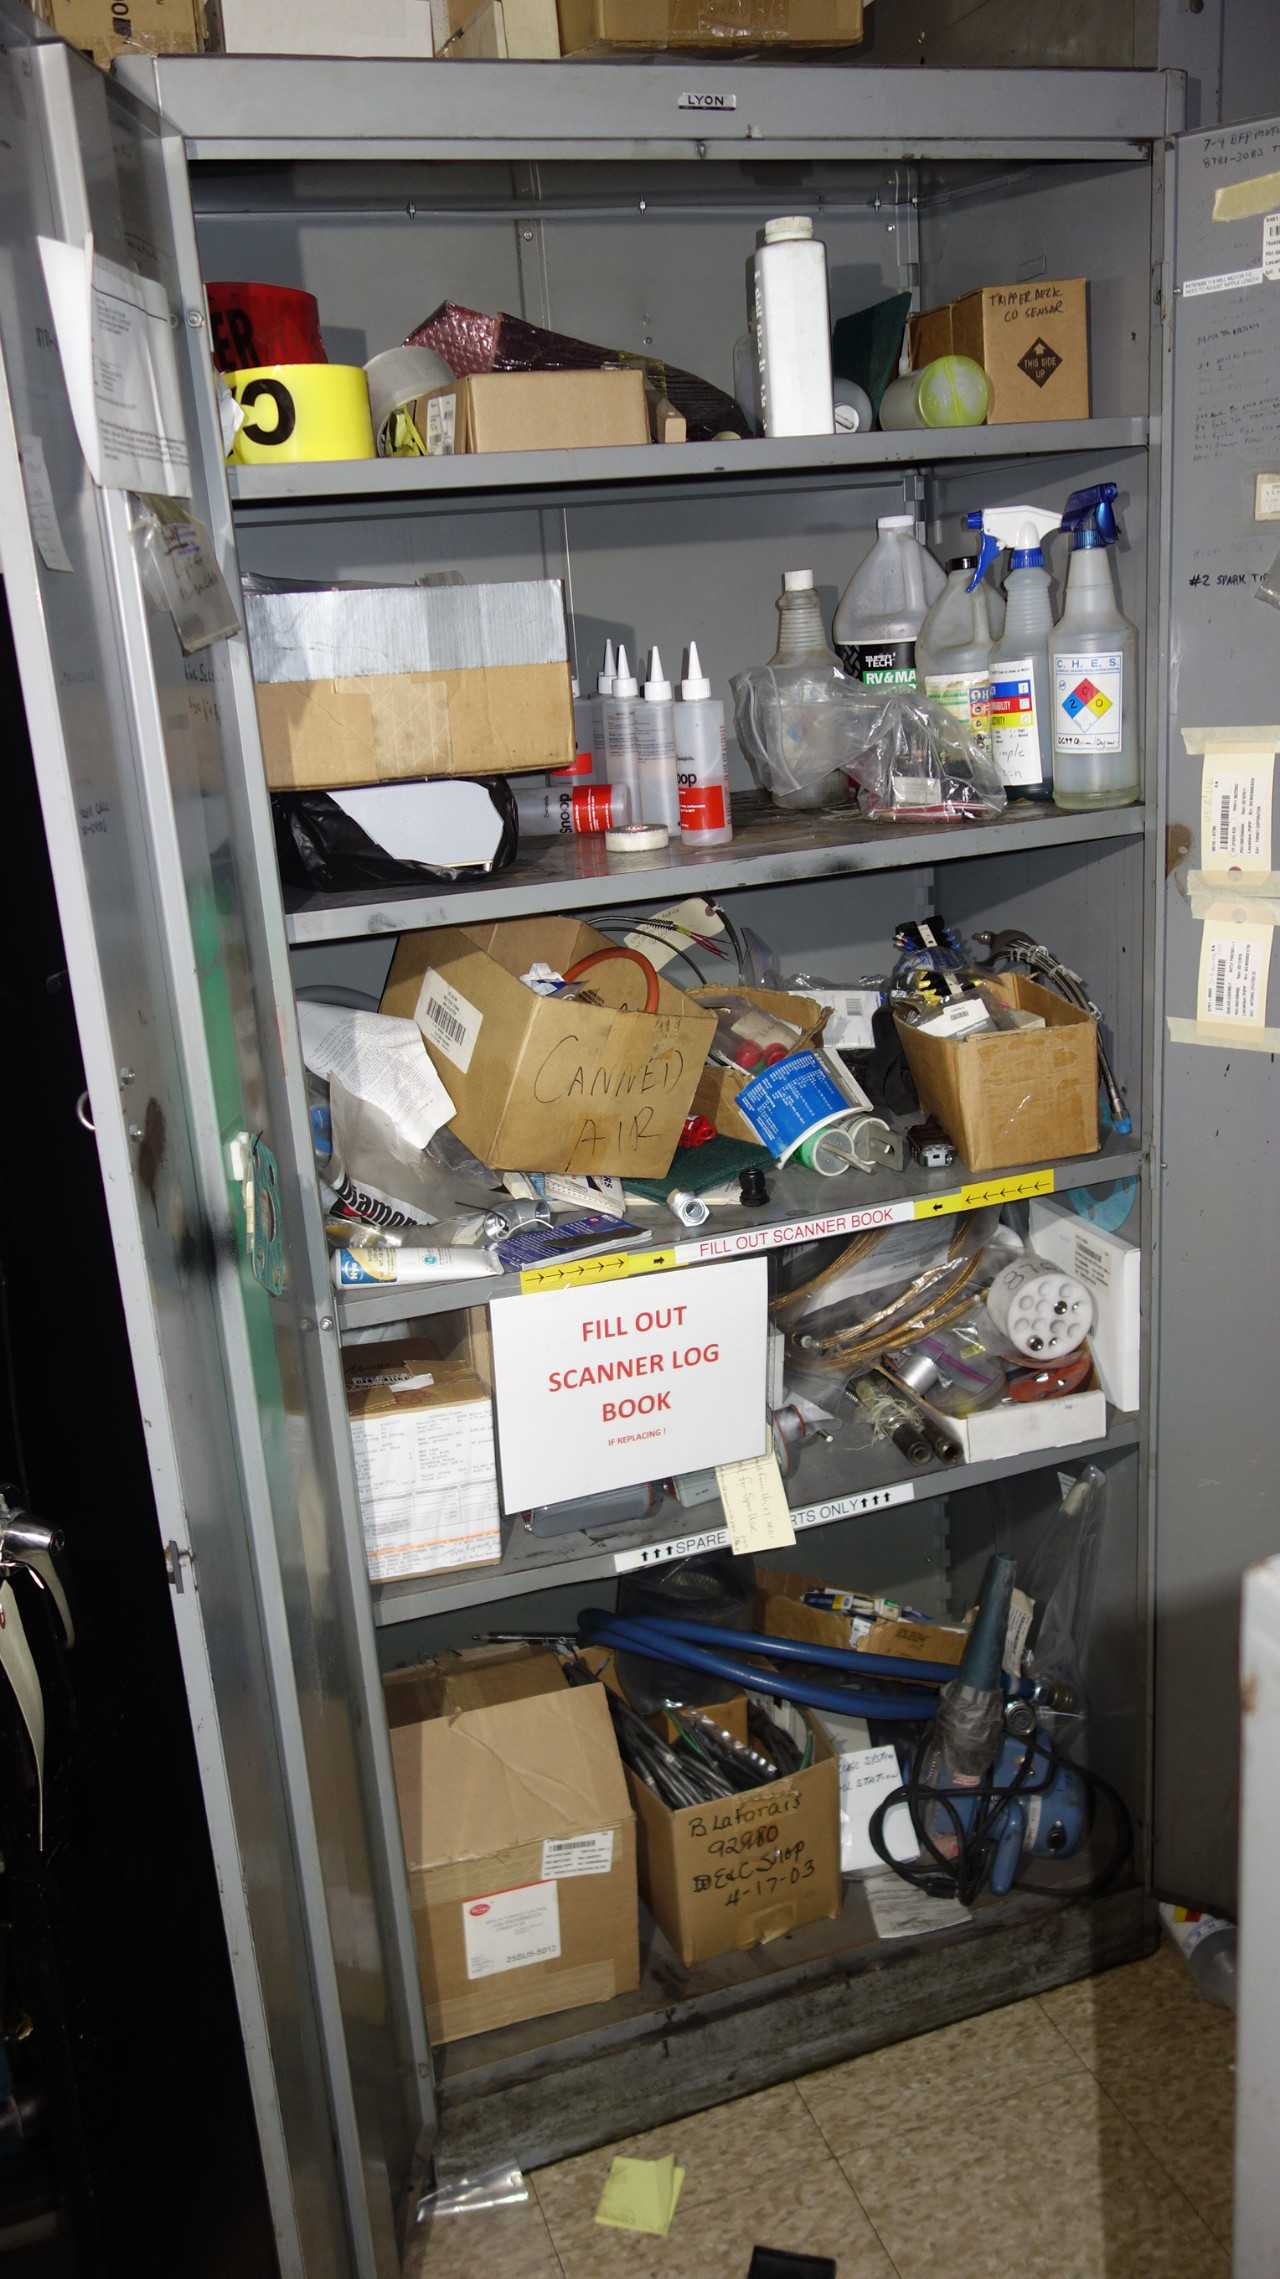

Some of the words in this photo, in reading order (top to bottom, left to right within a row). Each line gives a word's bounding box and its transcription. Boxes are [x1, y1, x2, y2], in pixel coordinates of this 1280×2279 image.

[688, 95, 724, 105] LYON
[1003, 310, 1019, 322] CO
[1024, 359, 1039, 369] THIS
[1041, 357, 1057, 369] SIDE
[1035, 369, 1046, 378] UP
[241, 378, 296, 446] C
[1188, 573, 1211, 587] #2
[1216, 573, 1247, 586] SPARK
[867, 659, 894, 668] TECH
[1070, 699, 1078, 709] 2
[534, 1034, 684, 1104] CANNED
[565, 1106, 660, 1172] AIR
[699, 1243, 732, 1257] FILL
[736, 1231, 770, 1250] OUT
[773, 1217, 847, 1243] SCANNER
[850, 1207, 894, 1228] BOOK
[581, 1316, 629, 1342] FILL
[635, 1305, 688, 1332] OUT
[548, 1353, 665, 1392] SCANNER
[671, 1343, 720, 1370] LOG
[602, 1390, 672, 1423] BOOK
[607, 1438, 616, 1447] IF
[616, 1428, 662, 1445] REPLACING
[675, 1532, 727, 1554] SPARE
[790, 1510, 816, 1527] RTS
[820, 1499, 860, 1520] ONLY
[688, 1816, 708, 1838] B
